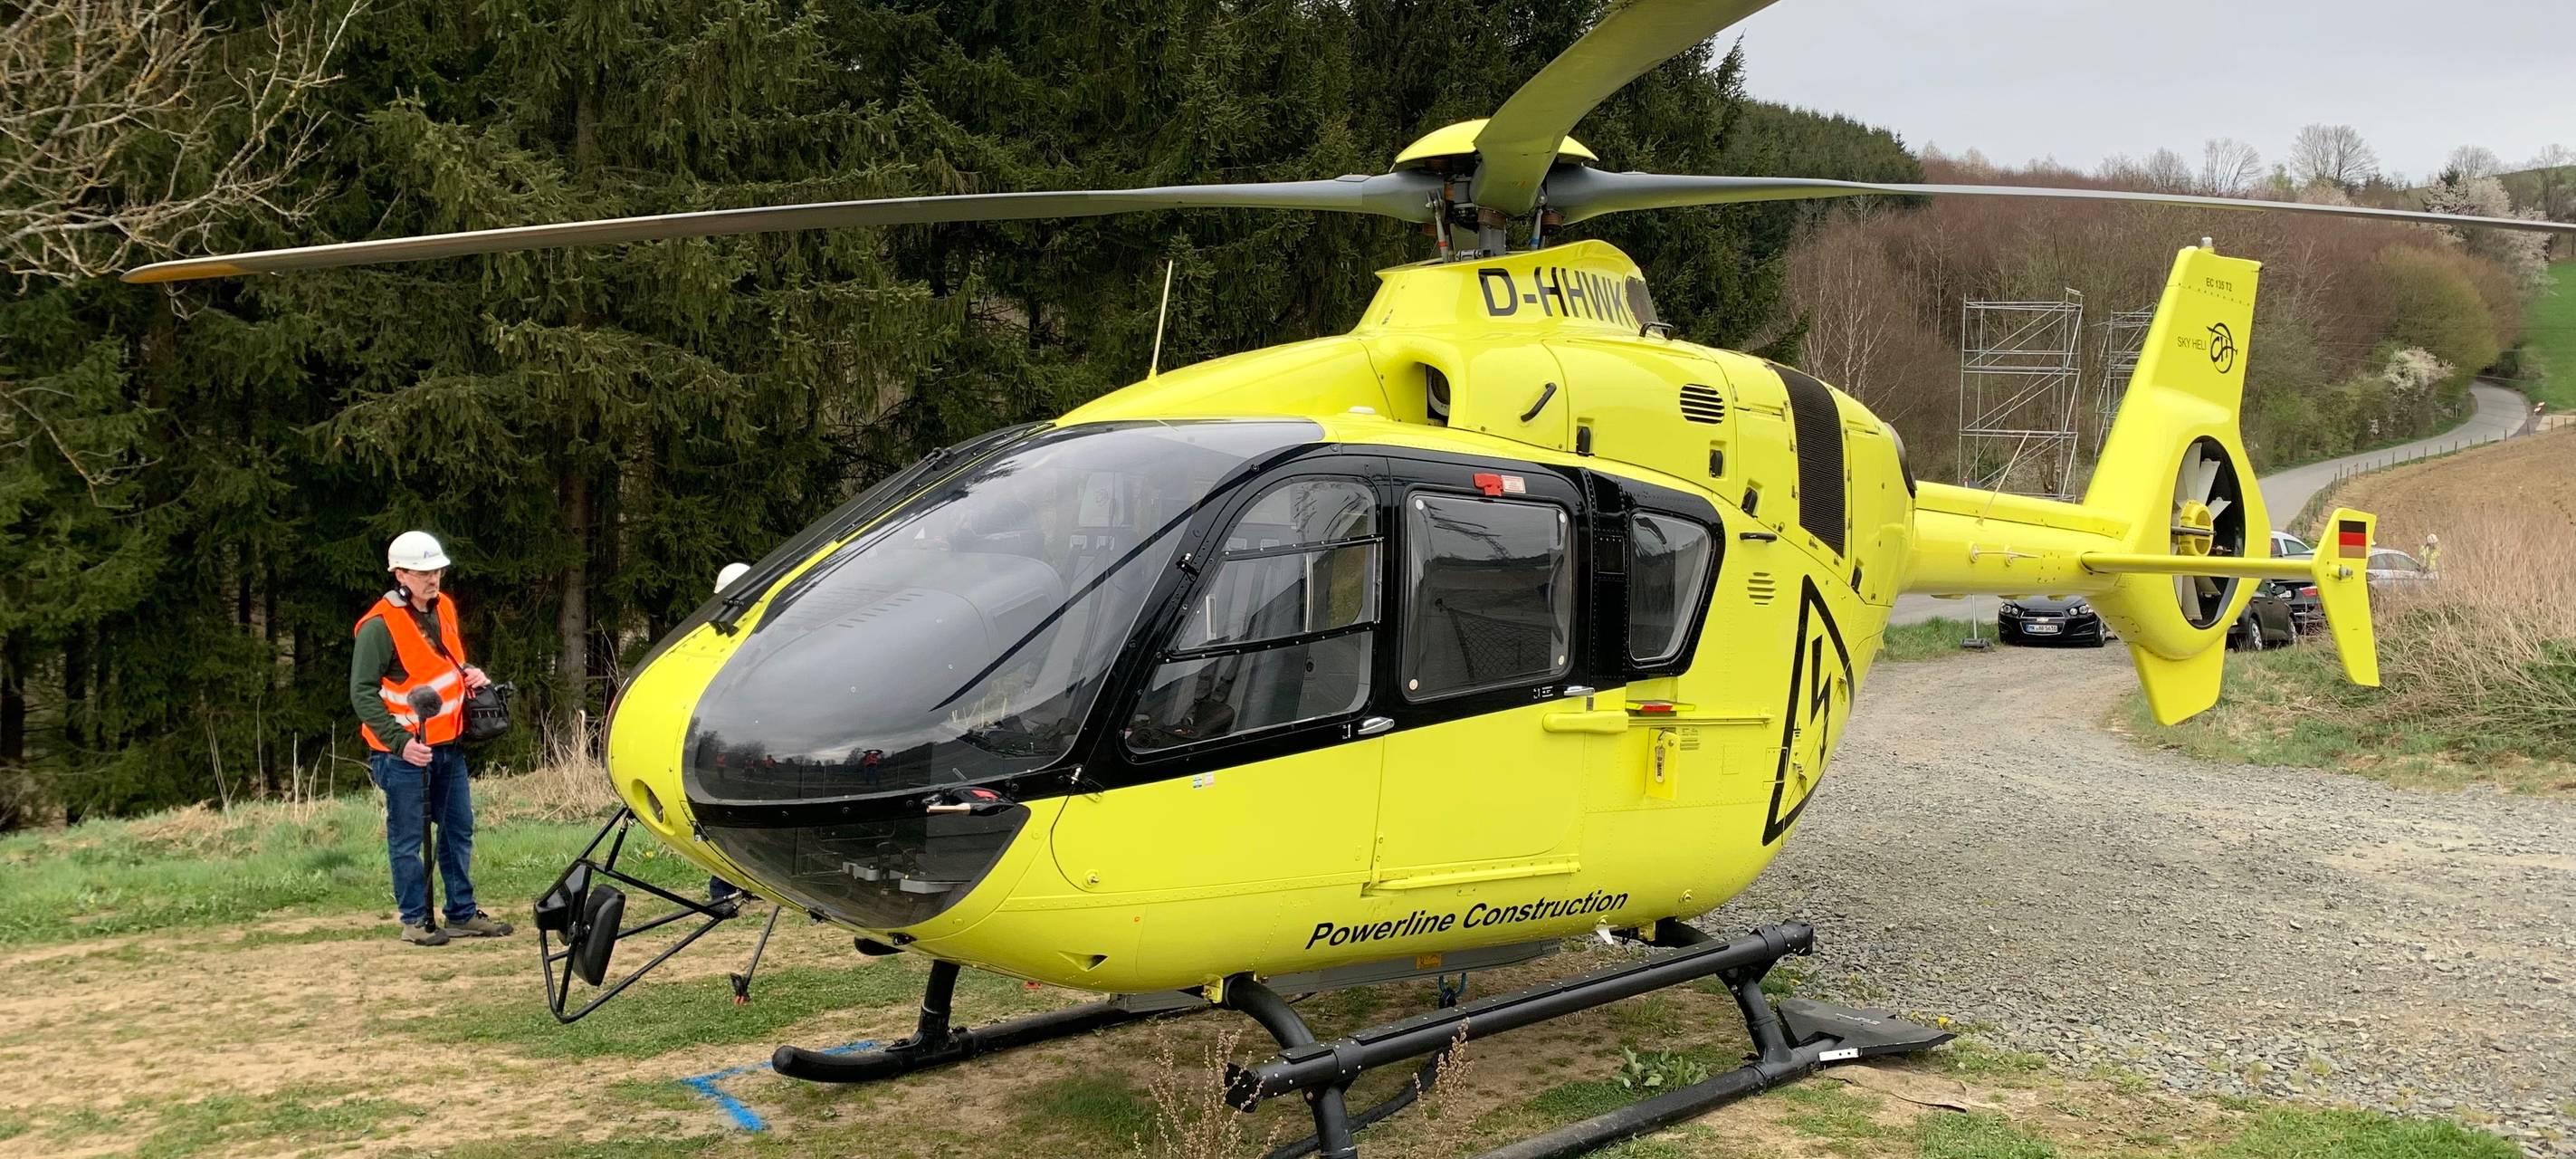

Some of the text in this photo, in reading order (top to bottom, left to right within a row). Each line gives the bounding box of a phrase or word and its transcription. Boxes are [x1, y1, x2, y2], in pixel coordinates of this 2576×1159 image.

[1478, 266, 1633, 330] D-HHWK
[2206, 277, 2232, 292] EC 135 T2
[2177, 336, 2207, 350] SKY HELI
[1305, 889, 1628, 950] Powerline Construction
